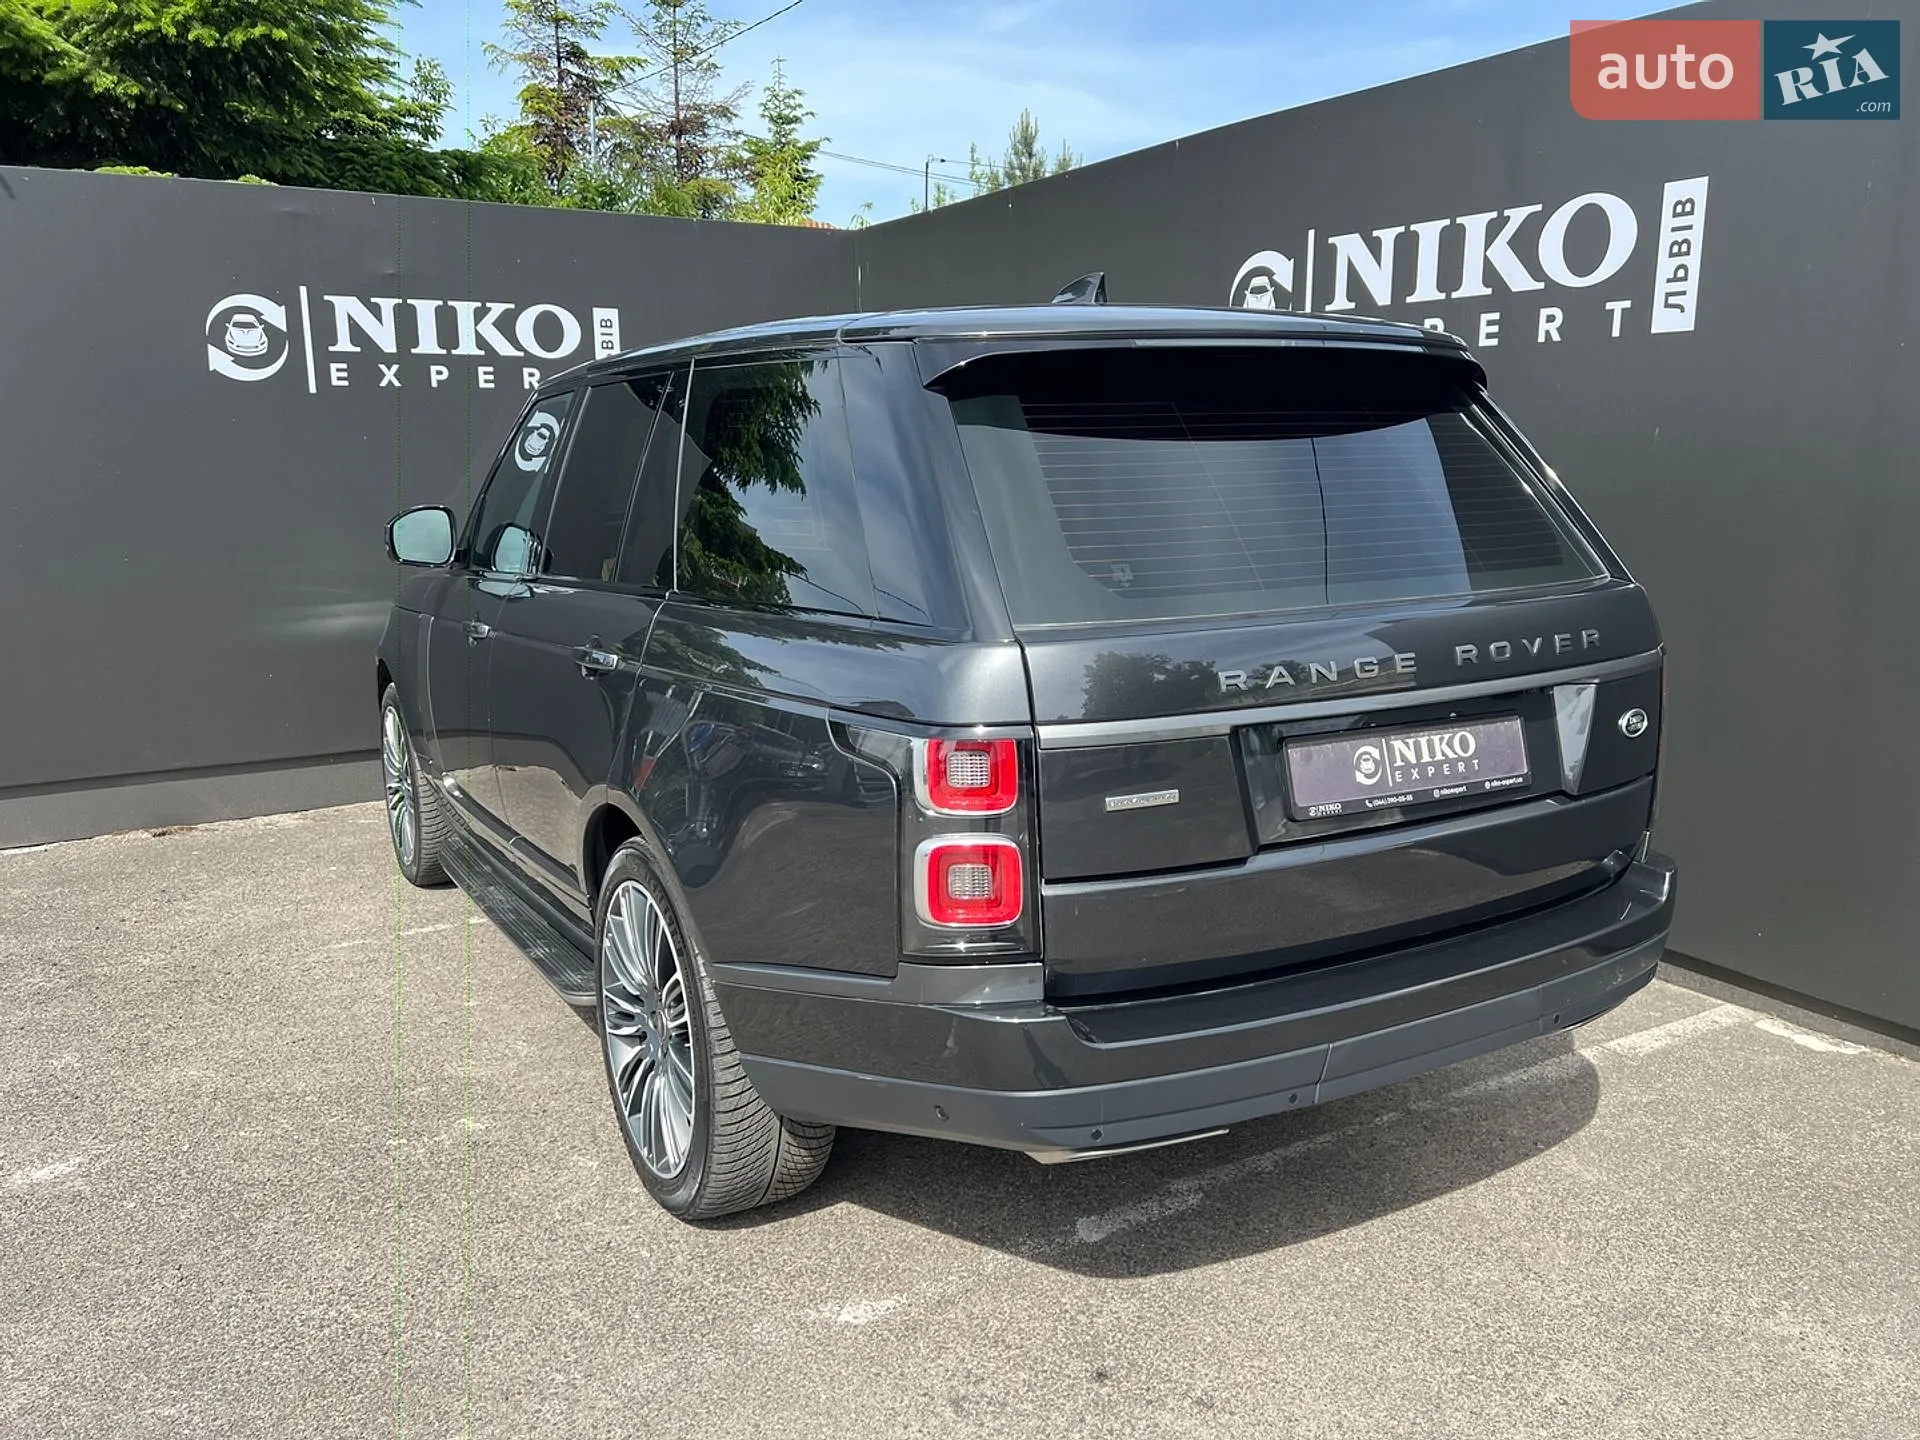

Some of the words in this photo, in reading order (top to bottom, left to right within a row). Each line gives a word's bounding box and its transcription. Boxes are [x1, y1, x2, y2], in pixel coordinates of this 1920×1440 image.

[1325, 192, 1638, 312] NIKO
[324, 294, 582, 359] NIKO
[600, 318, 614, 350] ВІВ
[330, 363, 542, 389] EXPER
[1218, 652, 1418, 693] RANGE
[1455, 628, 1601, 666] ROVER
[1390, 731, 1476, 767] NIKO
[1395, 759, 1480, 782] EXPERT
[1319, 802, 1342, 812] NIKO
